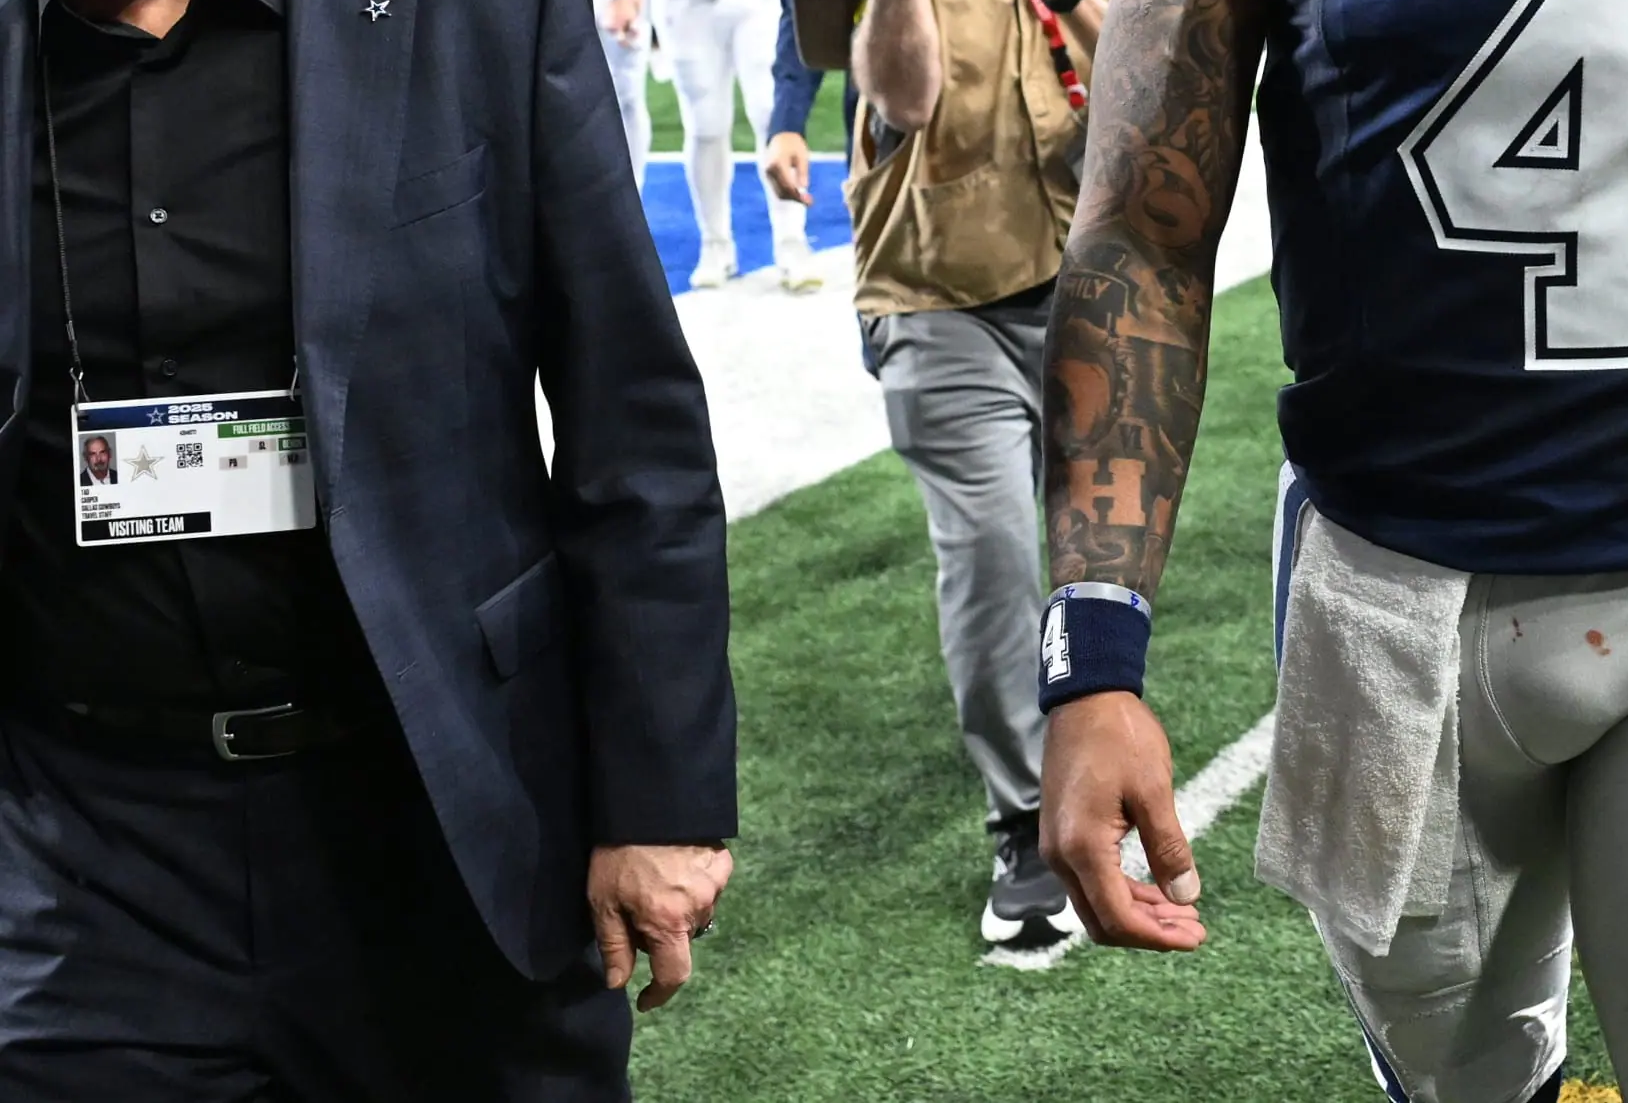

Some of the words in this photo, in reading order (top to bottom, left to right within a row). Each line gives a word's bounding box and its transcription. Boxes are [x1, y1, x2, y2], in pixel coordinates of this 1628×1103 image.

[167, 404, 213, 414] 2025
[168, 411, 238, 424] SEASON
[108, 519, 154, 537] VISITING
[155, 516, 185, 533] TEAM
[1041, 599, 1071, 685] 4
